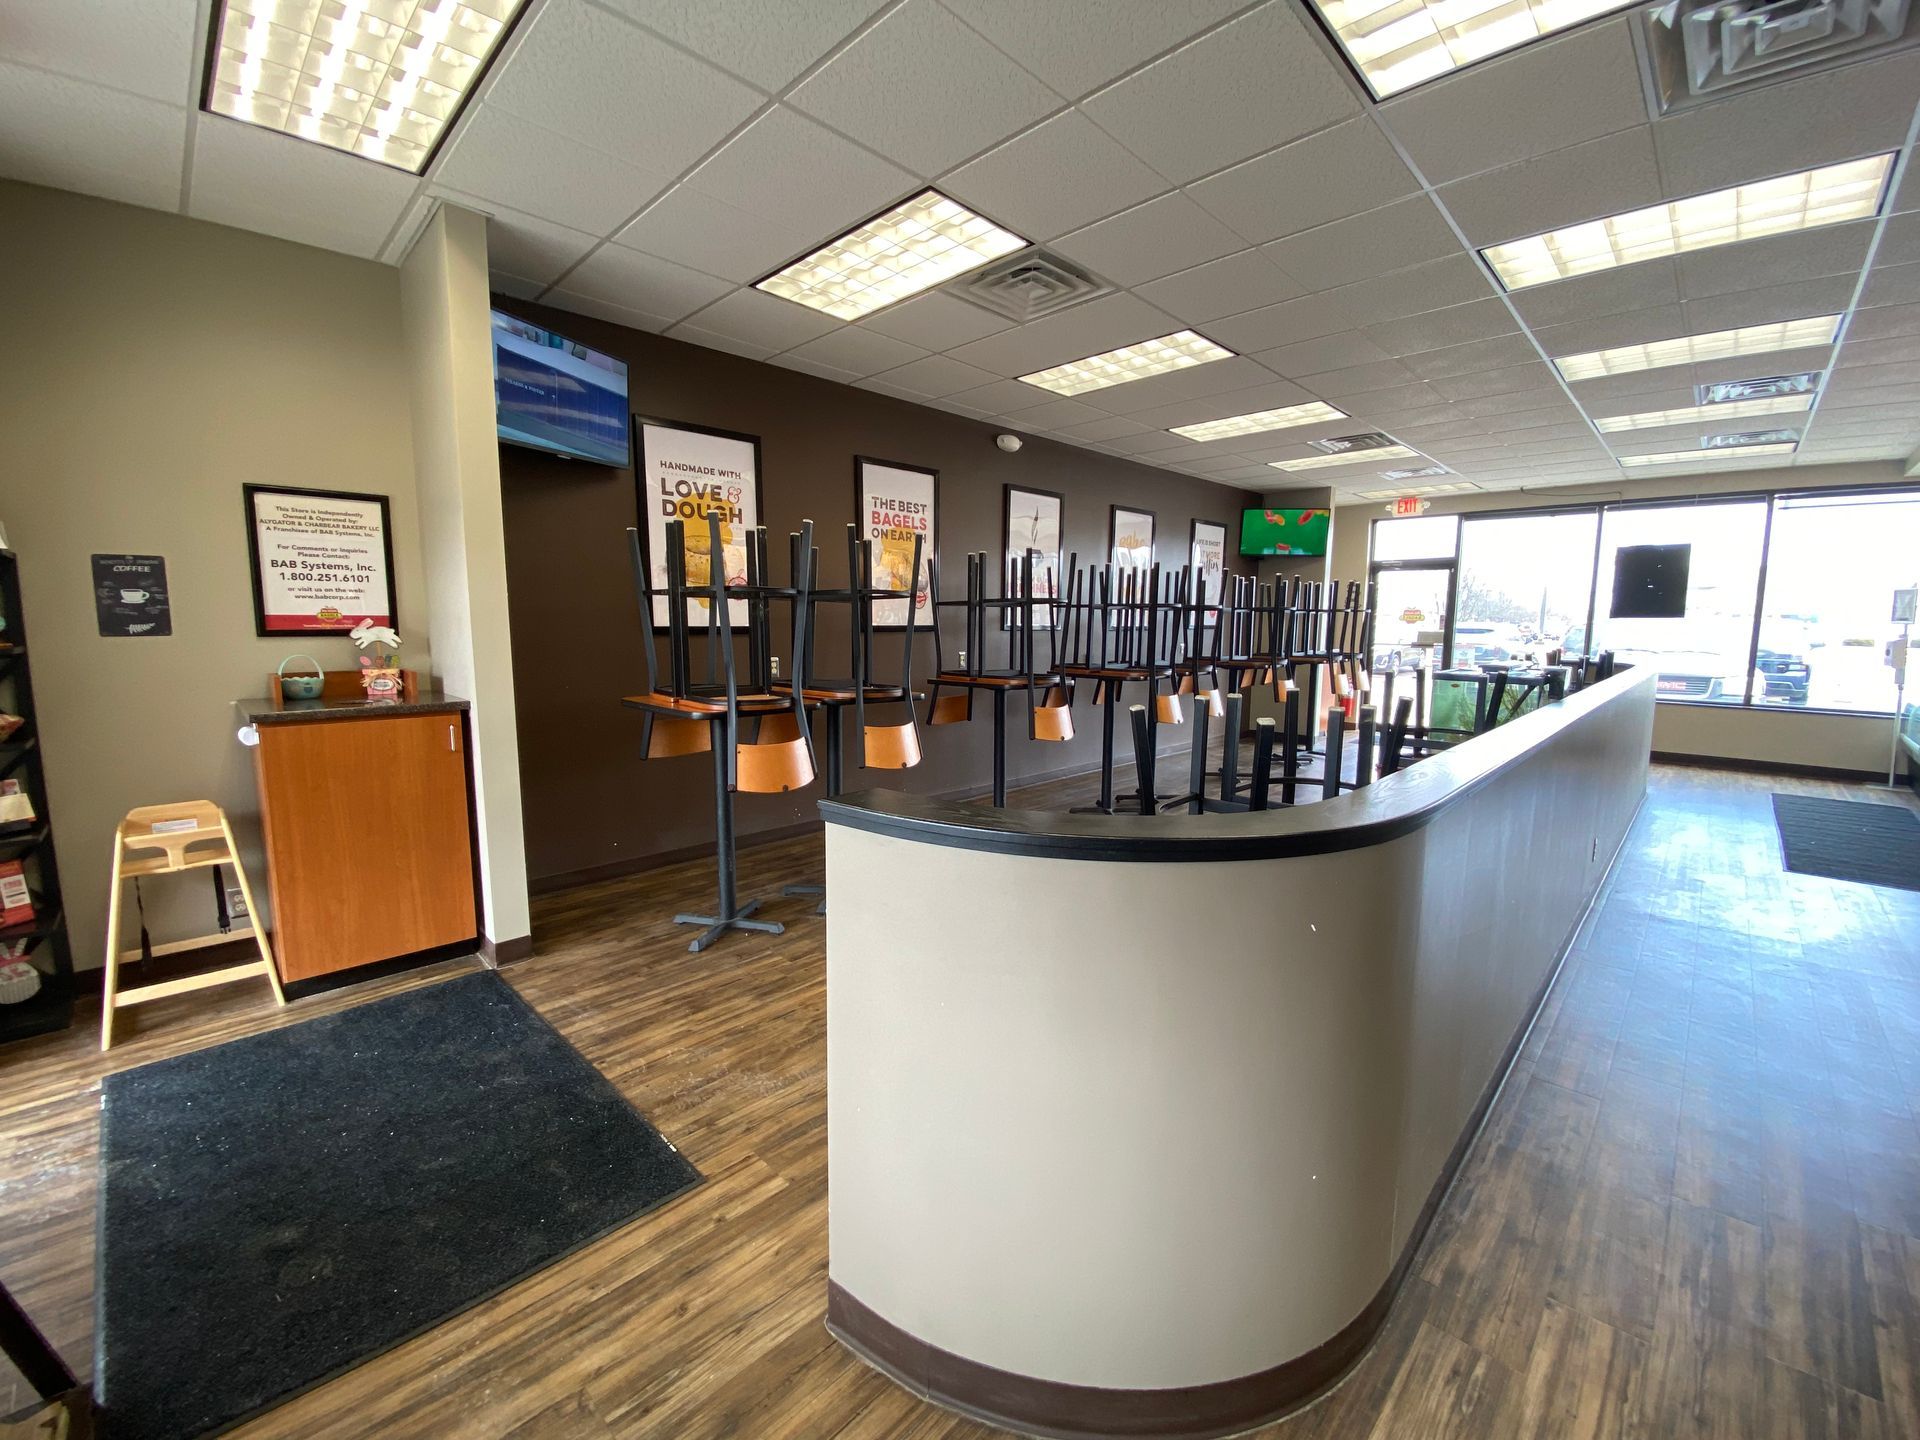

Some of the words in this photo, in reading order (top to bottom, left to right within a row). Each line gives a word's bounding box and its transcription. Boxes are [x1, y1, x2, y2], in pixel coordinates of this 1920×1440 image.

[660, 460, 716, 476] HANDMADE
[718, 469, 741, 480] WITH
[661, 477, 723, 503] LOVE
[727, 486, 742, 504] &
[662, 499, 743, 524] DOUGH
[871, 496, 896, 511] THE
[898, 500, 927, 515] BEST
[1397, 498, 1418, 513] EXIT
[315, 515, 347, 523] Operated
[348, 517, 359, 525] by:
[317, 508, 364, 519] Independently
[259, 518, 296, 526] ALYGATOR
[341, 523, 367, 531] BAKERY
[871, 510, 927, 531] BAGELS
[273, 526, 309, 534] Franchisee
[871, 527, 889, 540] ON
[890, 529, 927, 544] EARH
[291, 544, 329, 552] Comments
[112, 565, 152, 573] COFFEE
[270, 559, 298, 569] BAB
[301, 560, 353, 572] Systems,
[356, 563, 377, 572] Inc.
[279, 572, 371, 583] 1.800.251.6101
